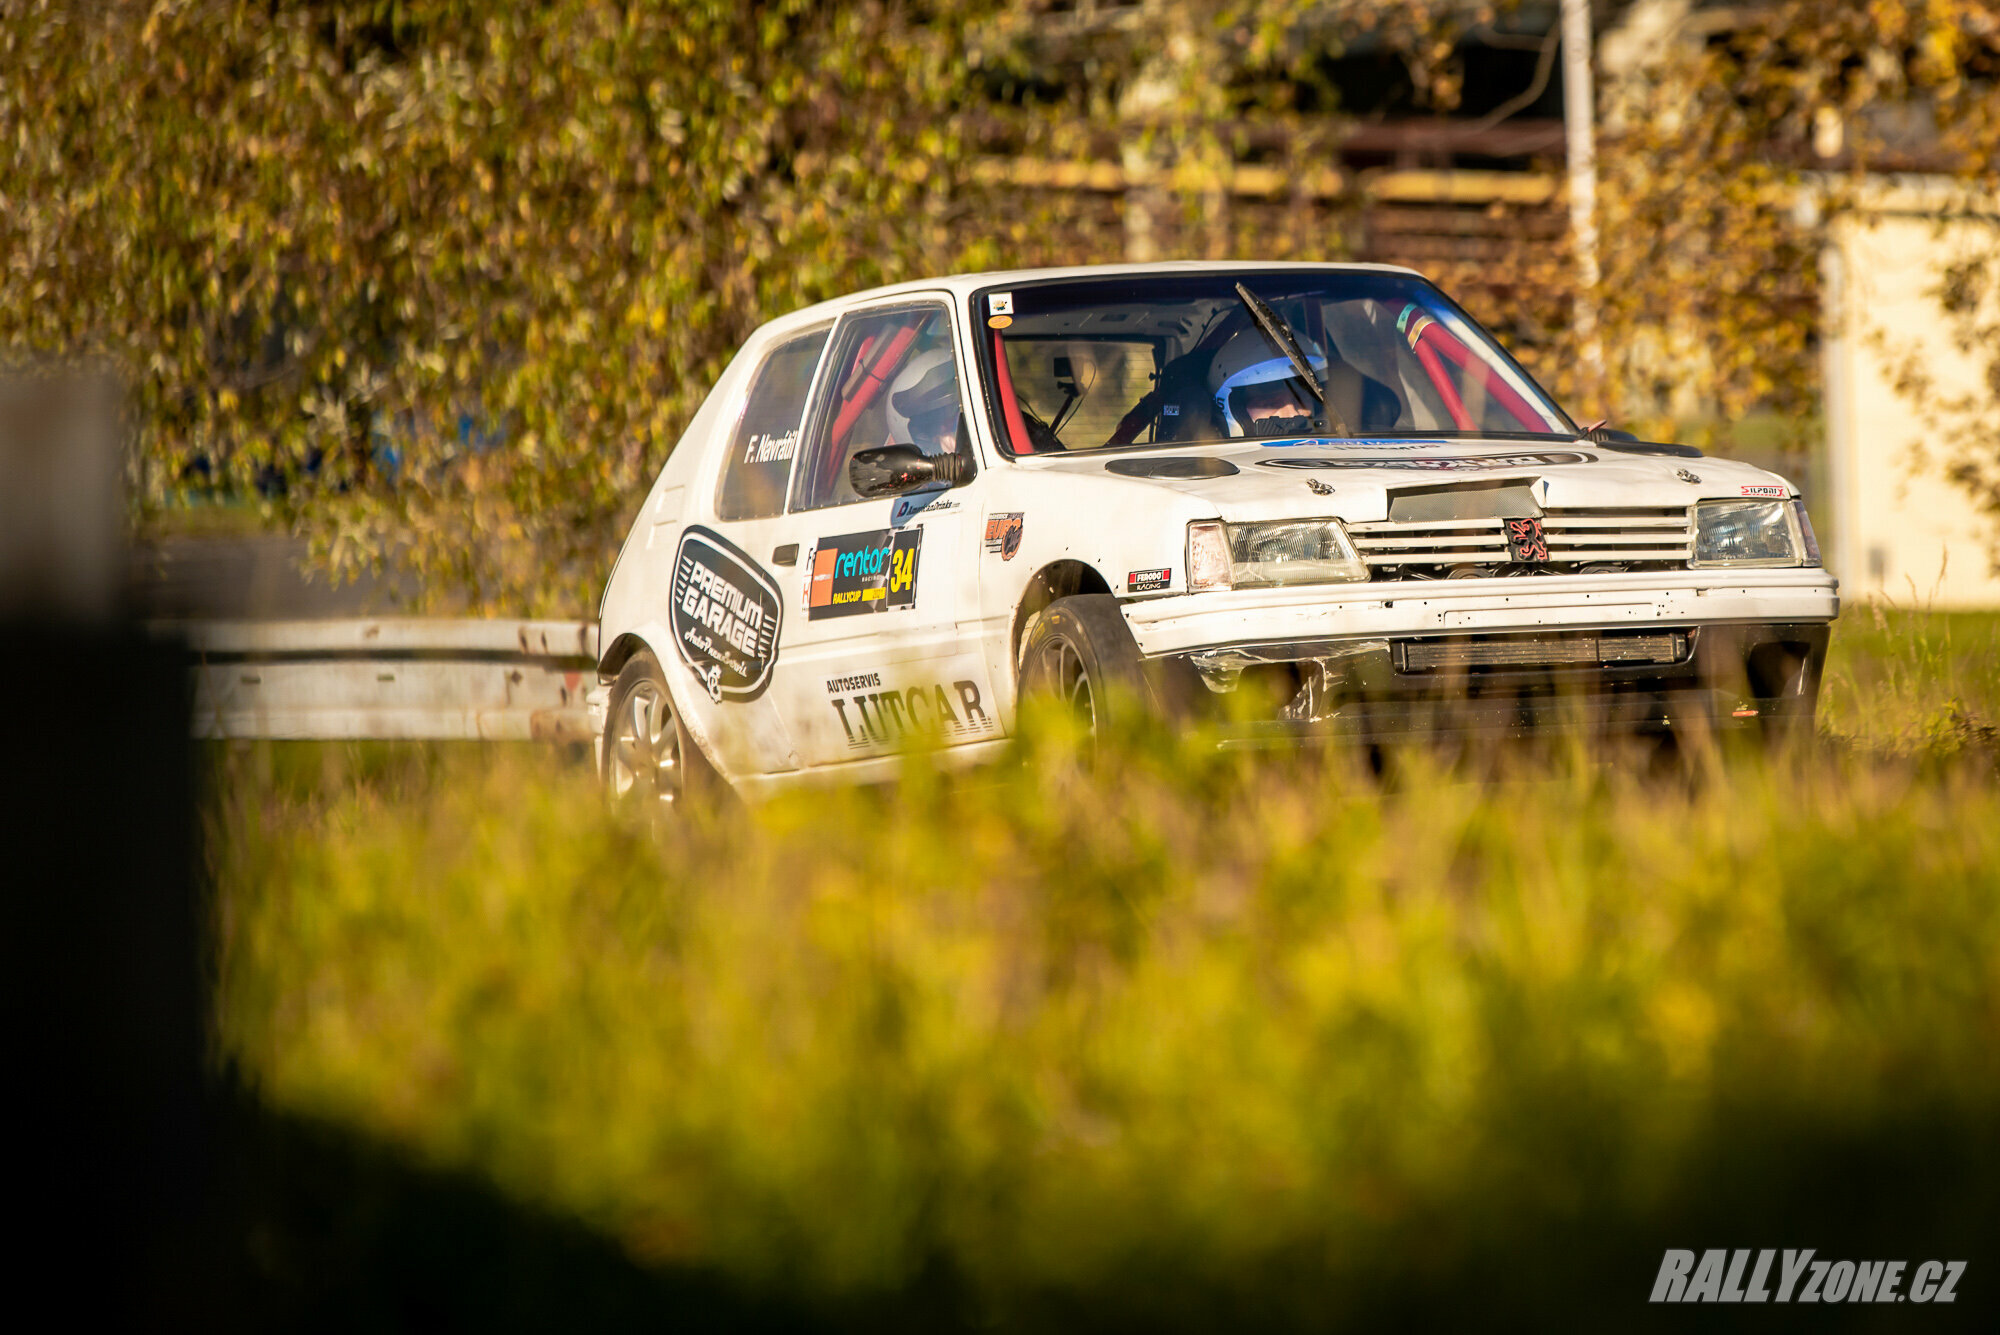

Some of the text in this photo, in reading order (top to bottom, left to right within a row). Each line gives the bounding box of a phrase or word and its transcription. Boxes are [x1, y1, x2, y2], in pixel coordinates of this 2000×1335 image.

[743, 434, 759, 464] F.
[834, 545, 890, 579] rentor
[890, 548, 915, 593] 34
[1137, 571, 1161, 582] FERODO
[689, 560, 764, 630] PREMIUM
[832, 590, 862, 605] RALLYCUP
[681, 585, 759, 658] GARAGE
[826, 672, 881, 694] AUTOSERVIS
[831, 679, 993, 750] LUTCAR
